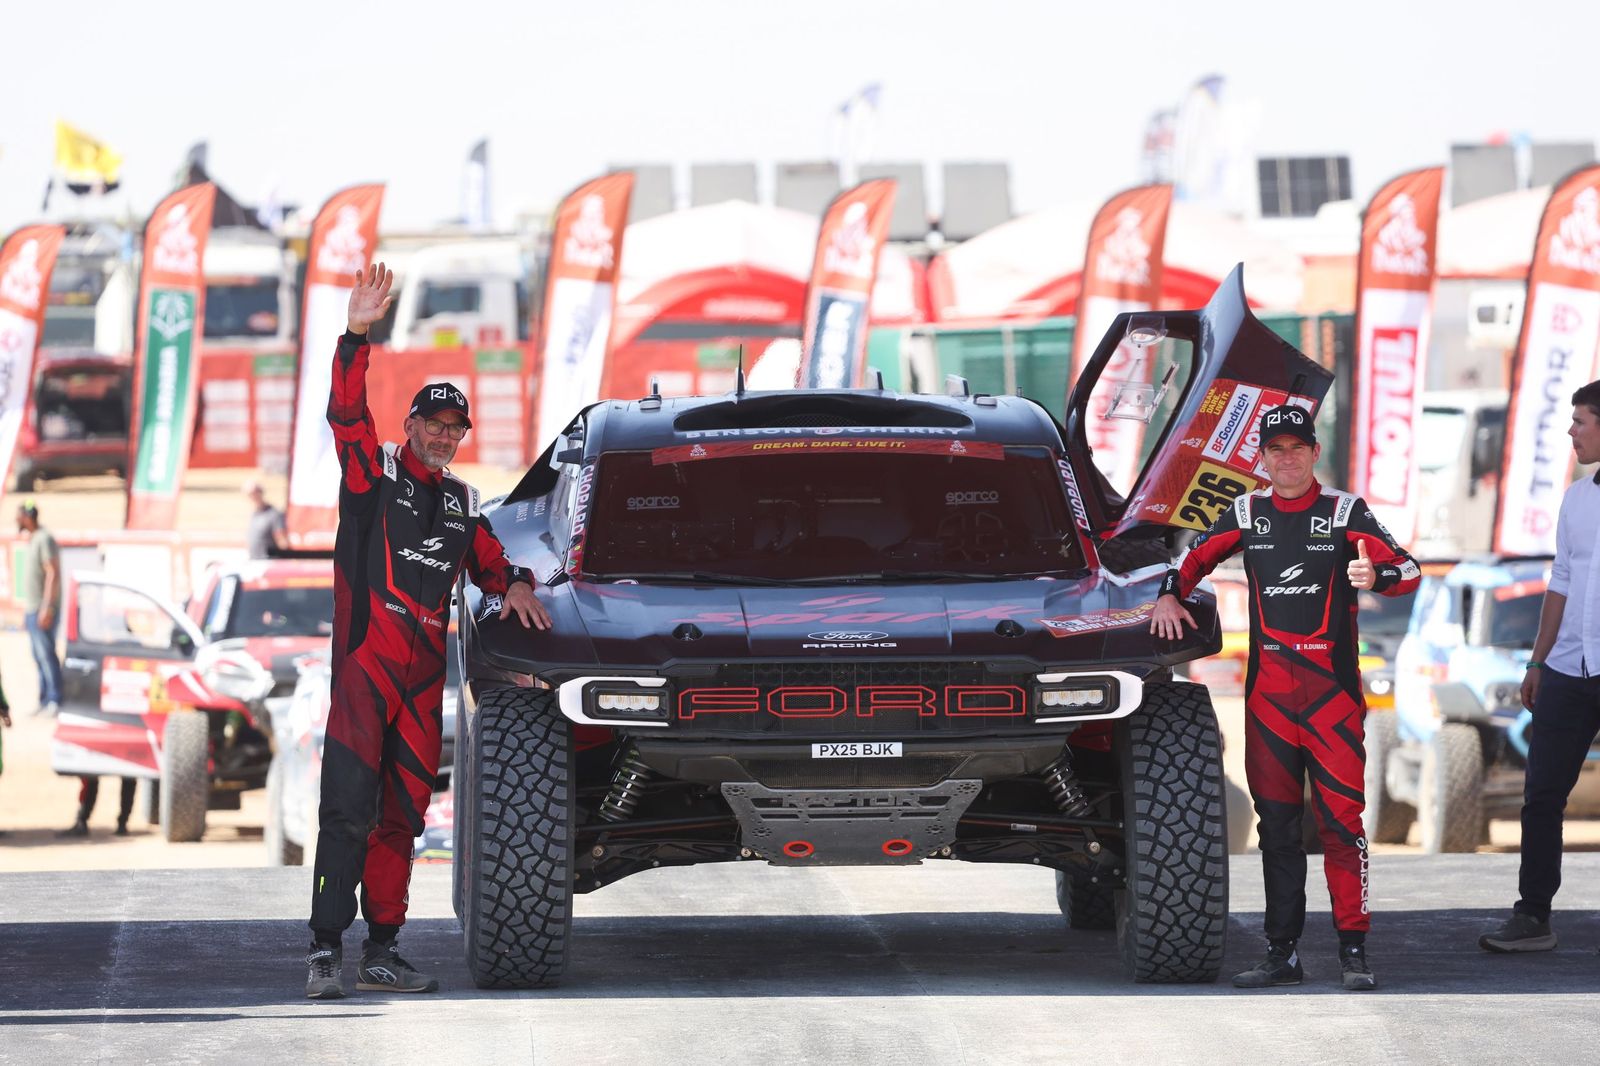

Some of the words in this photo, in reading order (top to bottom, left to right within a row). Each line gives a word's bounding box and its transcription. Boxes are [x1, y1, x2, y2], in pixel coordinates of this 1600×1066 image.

[1206, 394, 1221, 414] DARE.
[1213, 398, 1226, 416] LIVE
[1211, 393, 1249, 453] BFGoodrich
[1369, 335, 1416, 501] MOTUL
[686, 428, 802, 439] BENSON
[846, 427, 961, 435] CHERRY
[752, 441, 808, 450] DREAM.
[572, 464, 595, 537] CHOPARD
[627, 495, 680, 511] sparco
[945, 490, 999, 505] sparco
[1057, 458, 1090, 531] CHOPARD
[1179, 471, 1246, 530] 236
[444, 521, 466, 532] YACCO
[397, 548, 452, 572] spark
[1263, 583, 1323, 597] spark
[385, 602, 407, 614] sparco
[672, 605, 1041, 628] spark
[1109, 603, 1156, 620] 2026
[1066, 623, 1105, 632] SAUDI
[1104, 614, 1149, 627] ARABIA
[824, 631, 873, 640] Ford
[678, 685, 1026, 719] FORD
[819, 744, 858, 756] PX25
[862, 743, 894, 756] BJK
[781, 793, 923, 809] RAPTOR
